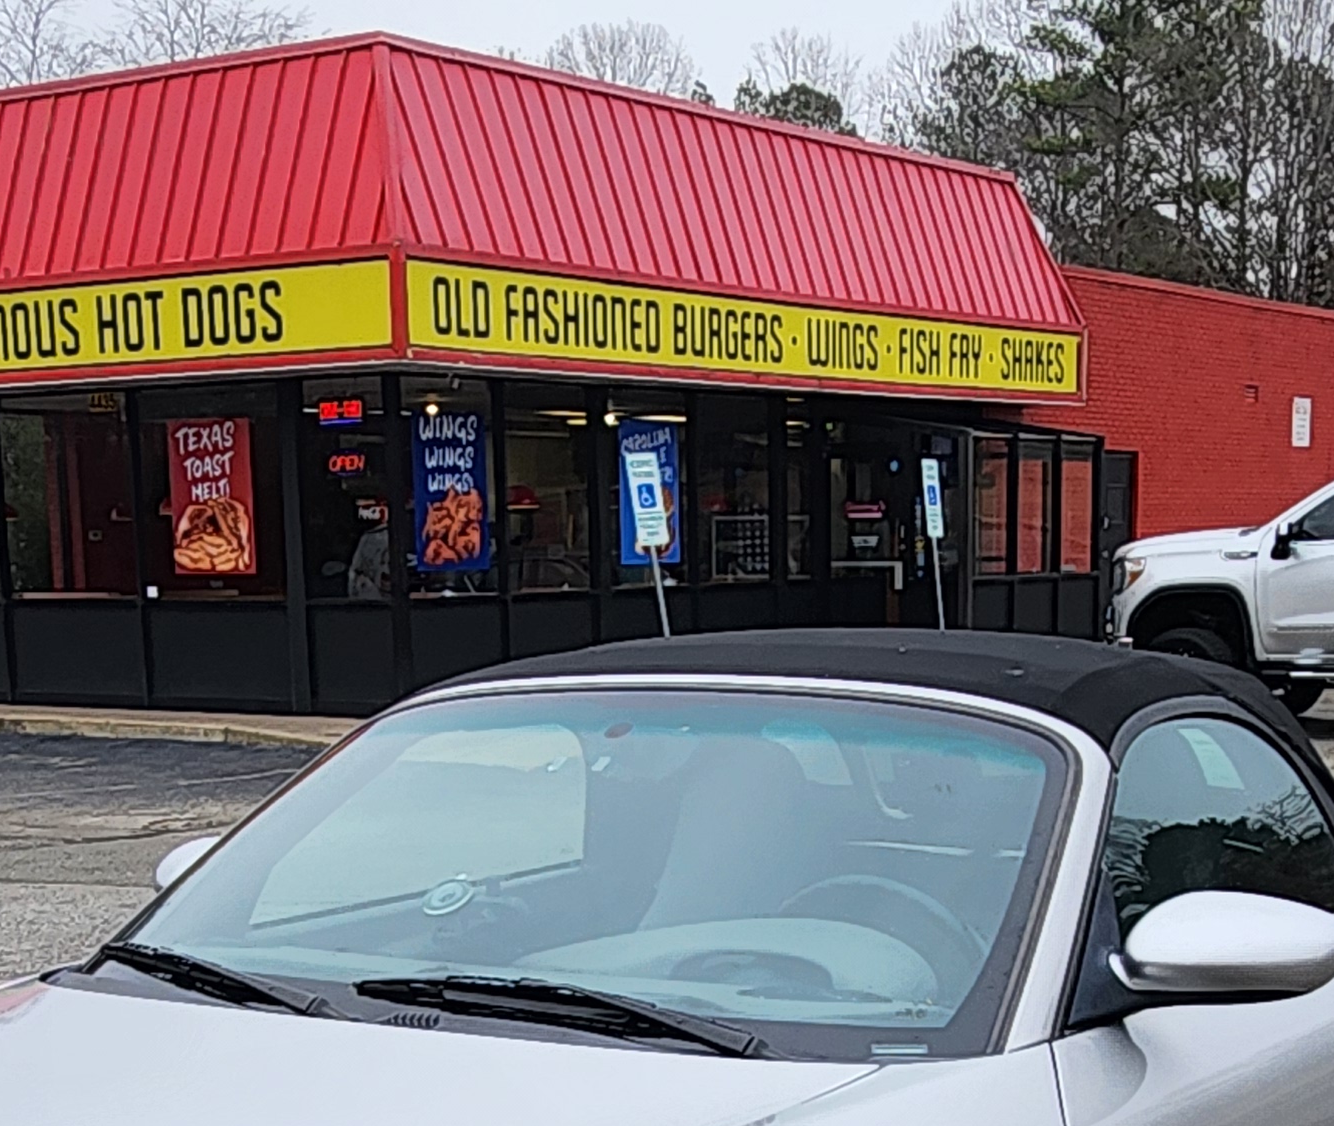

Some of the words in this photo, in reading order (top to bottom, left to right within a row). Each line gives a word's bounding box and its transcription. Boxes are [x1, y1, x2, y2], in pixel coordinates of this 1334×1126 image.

[95, 291, 164, 354] HOT
[181, 280, 283, 348] DOGS
[433, 276, 490, 339] OLD
[505, 284, 660, 353] FASHIONED
[673, 303, 783, 363] BURGERS
[807, 317, 878, 371] WINGS
[899, 328, 940, 376] FISH
[949, 333, 982, 379] FRY
[1001, 337, 1064, 384] SHAKES
[174, 421, 235, 455] TEXAS
[419, 415, 478, 446] WINGS
[183, 451, 234, 481] TOAST
[329, 454, 365, 472] OPEN
[425, 446, 474, 472] WINGS
[428, 472, 474, 495] WINGS
